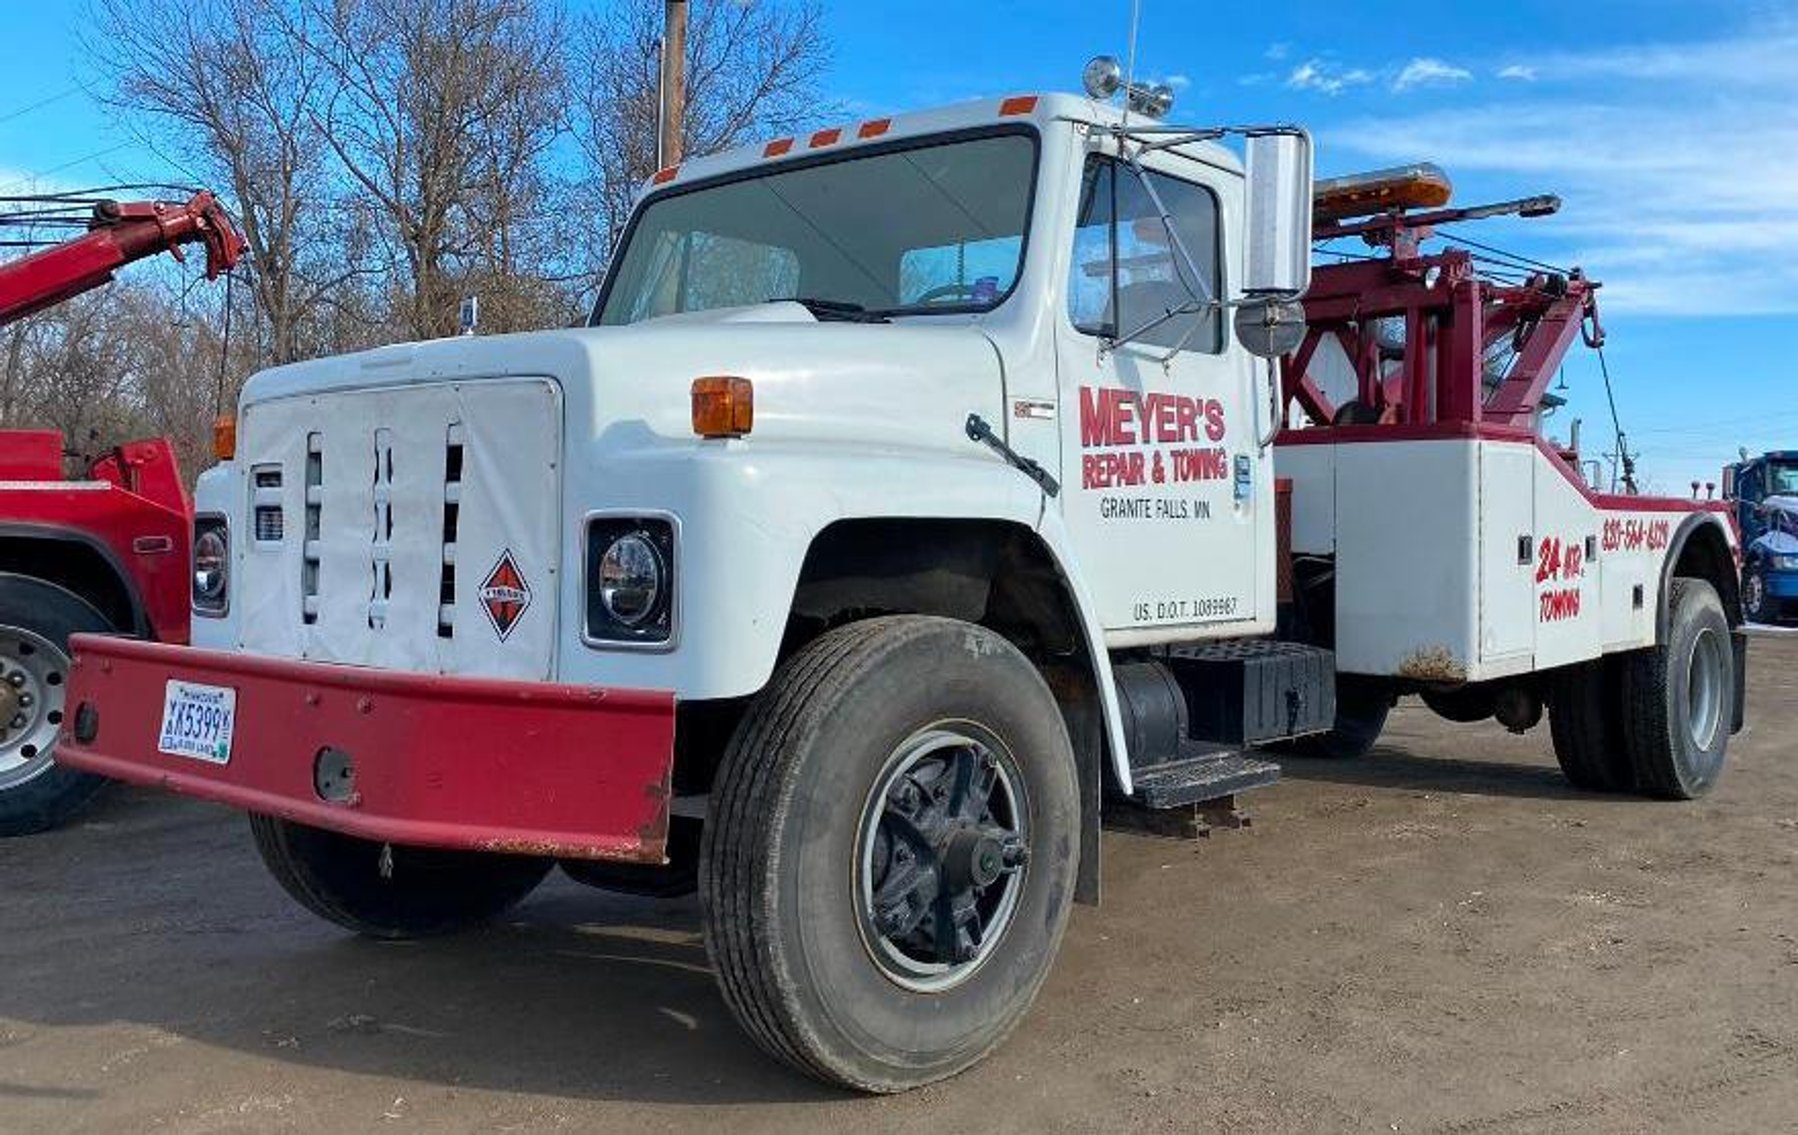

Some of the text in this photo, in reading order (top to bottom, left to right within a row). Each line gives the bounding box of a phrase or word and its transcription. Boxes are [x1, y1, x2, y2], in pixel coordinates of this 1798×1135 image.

[1079, 386, 1226, 447] MEYER'S
[1082, 451, 1146, 489] REPAIR
[1151, 450, 1165, 484] &
[1170, 447, 1228, 482] TOWING
[1100, 497, 1152, 519] GRANITE
[1194, 500, 1211, 519] MN
[1536, 536, 1561, 583] 24
[1540, 589, 1581, 623] TOWING
